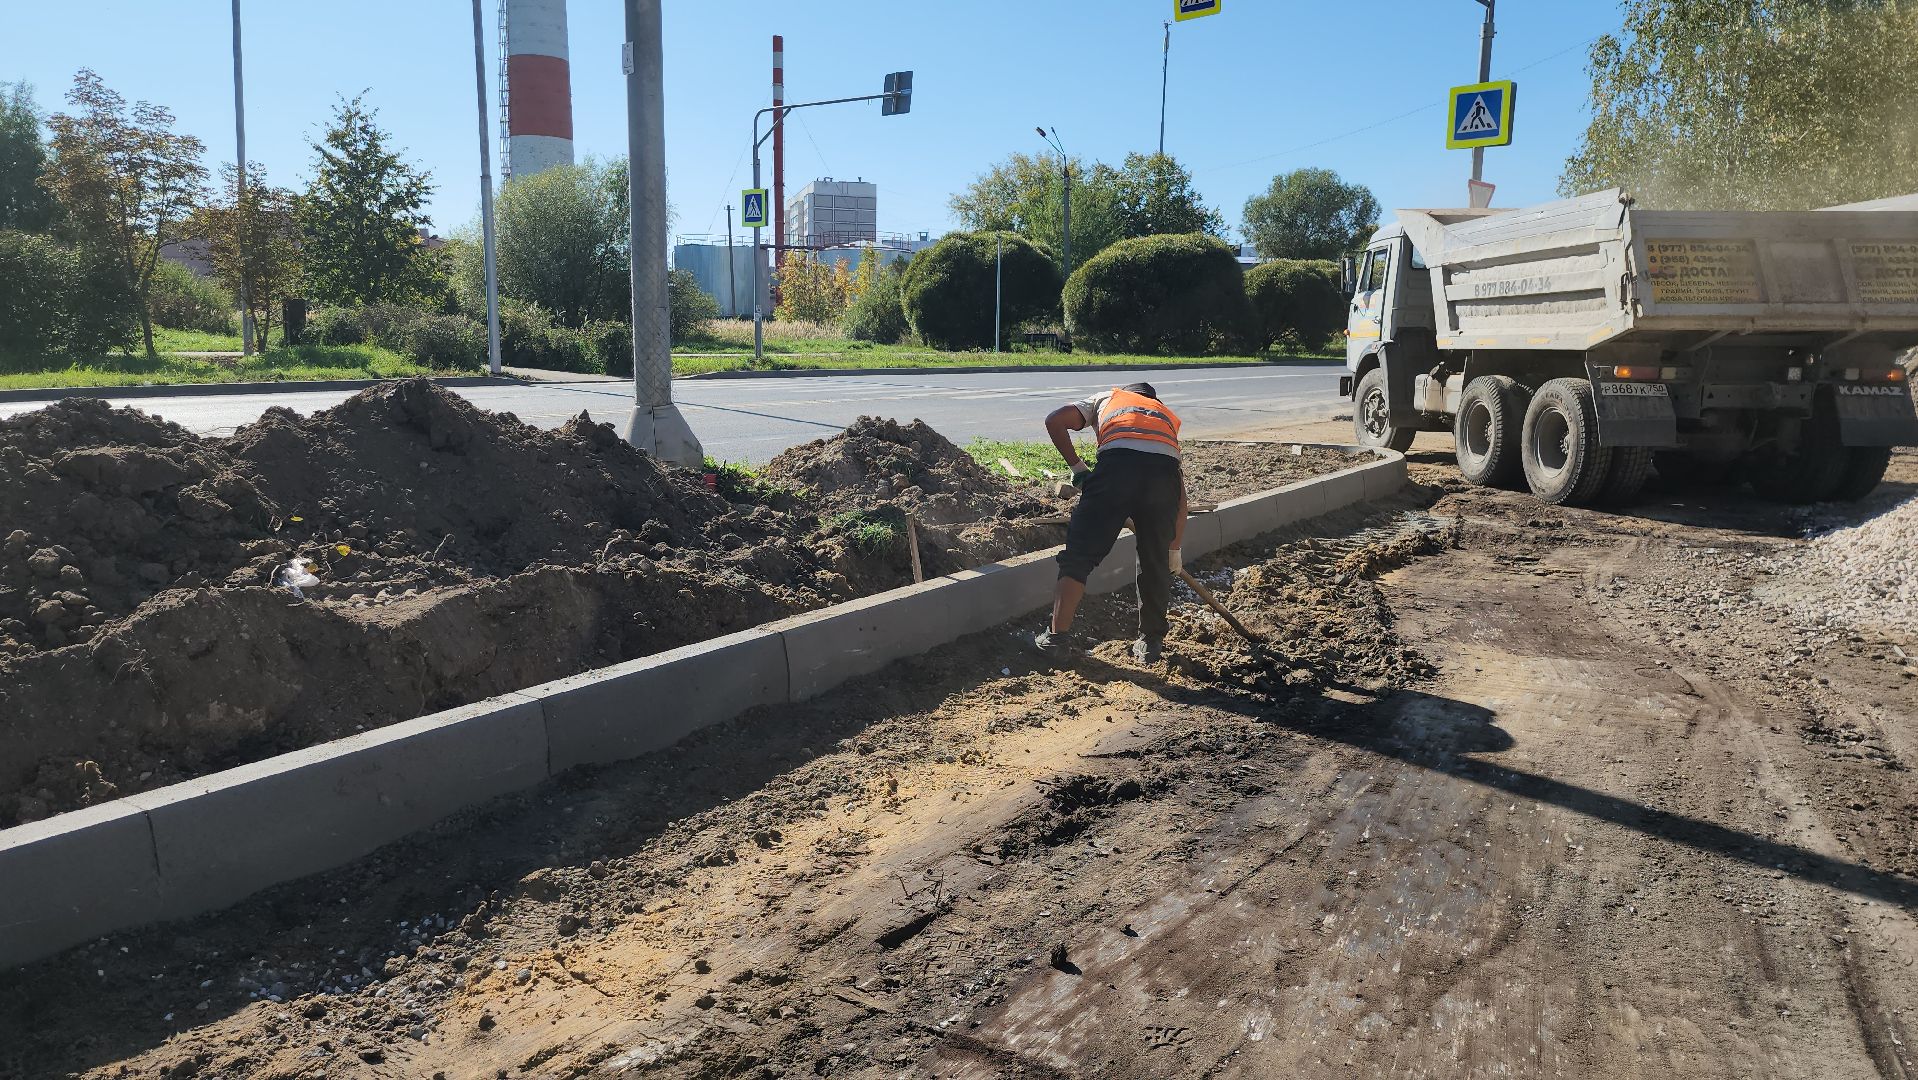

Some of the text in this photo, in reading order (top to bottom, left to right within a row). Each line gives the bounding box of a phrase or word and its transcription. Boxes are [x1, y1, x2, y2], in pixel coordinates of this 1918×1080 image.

[1474, 276, 1552, 297] 8 977 884-04-34
[1839, 385, 1905, 396] KAMAZ
